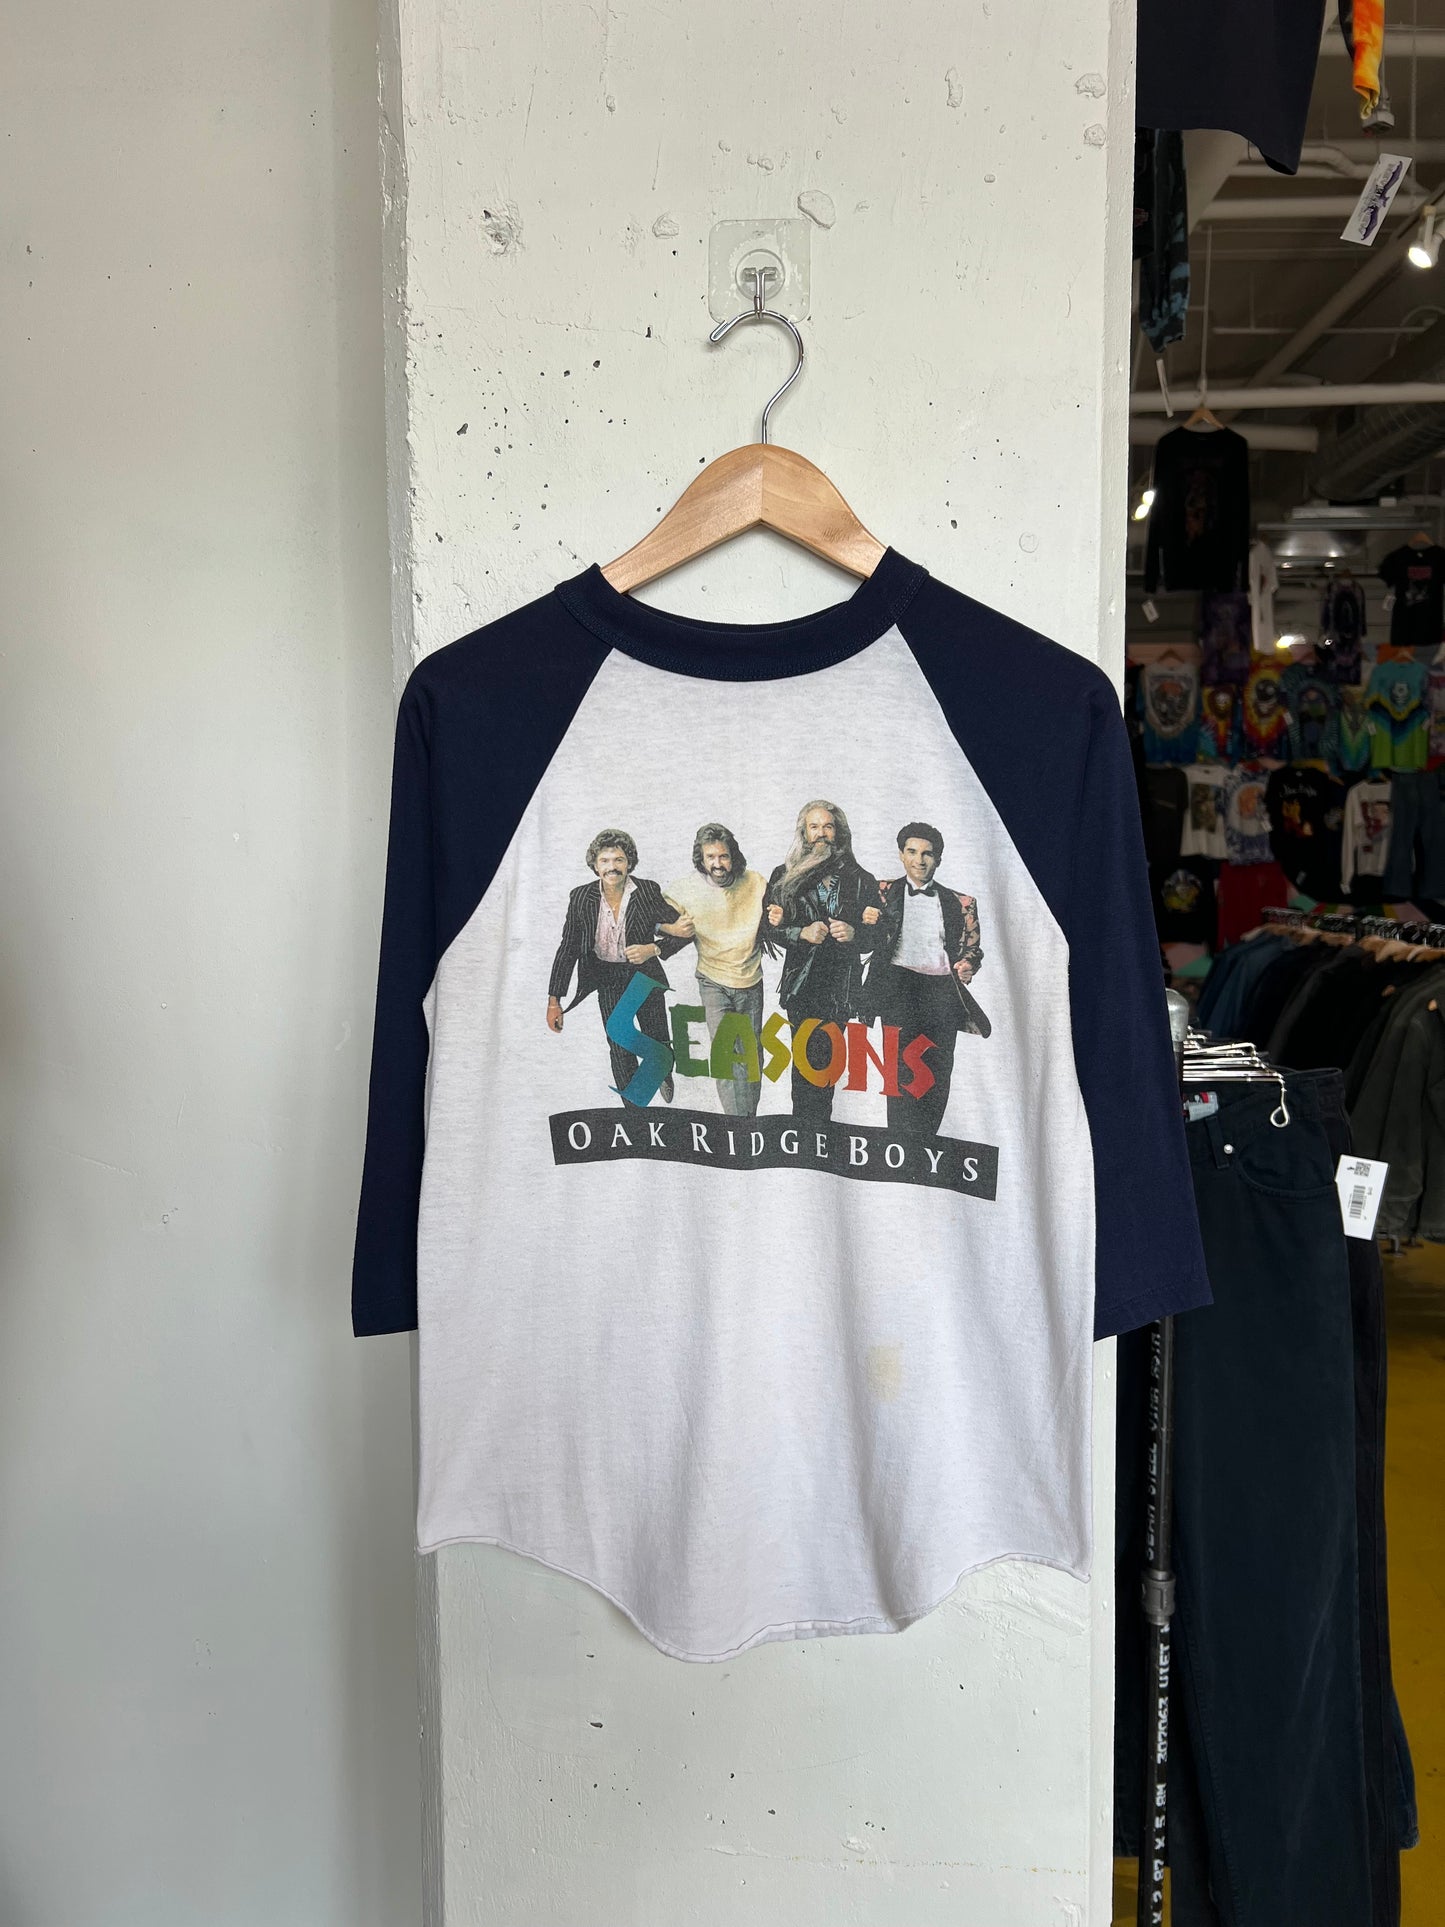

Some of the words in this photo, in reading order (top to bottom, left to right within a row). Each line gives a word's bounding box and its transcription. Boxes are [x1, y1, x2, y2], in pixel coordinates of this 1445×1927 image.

[606, 971, 941, 1107] SEASONS
[568, 1121, 666, 1150] OAK
[692, 1122, 829, 1159] RIDGE
[849, 1136, 979, 1182] BOYS
